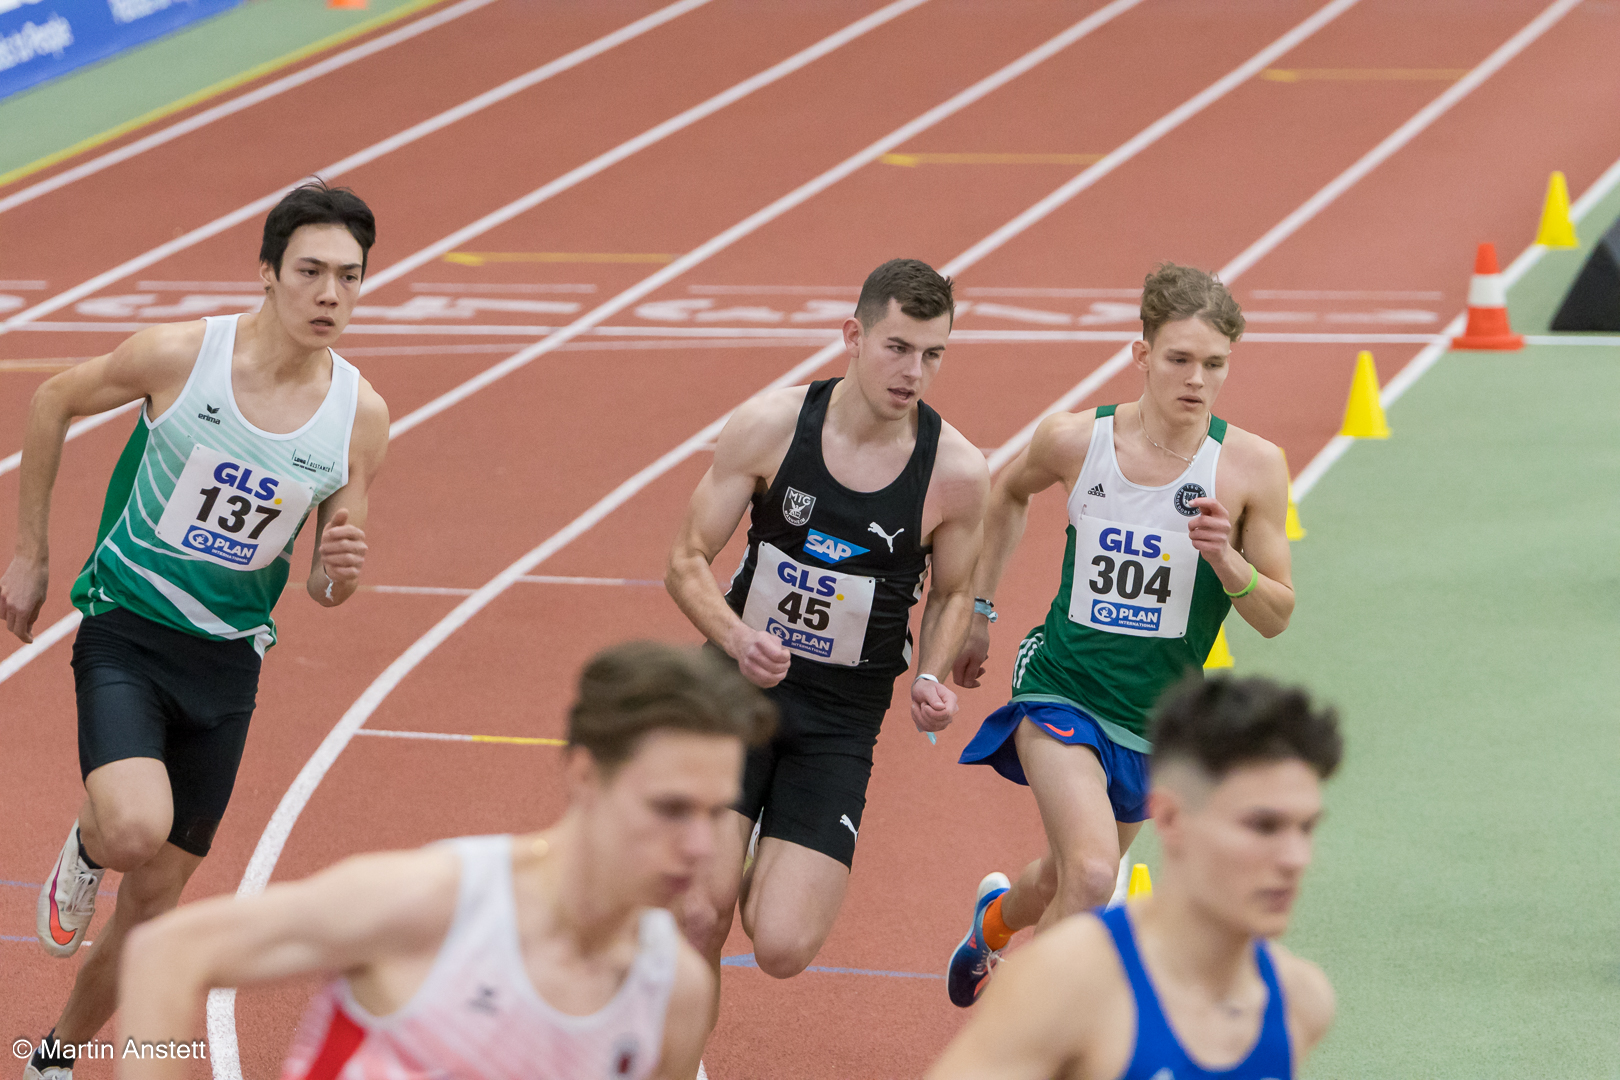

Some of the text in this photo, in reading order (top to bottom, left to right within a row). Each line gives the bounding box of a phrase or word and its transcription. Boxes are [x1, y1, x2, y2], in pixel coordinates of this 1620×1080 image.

[198, 412, 221, 425] erima
[788, 490, 811, 506] MTG
[1087, 489, 1106, 498] adidas
[196, 486, 282, 540] 137
[213, 538, 254, 558] PLAN
[805, 534, 852, 561] SAP
[211, 549, 248, 563] INTERNATIONAL
[1088, 554, 1172, 604] 304
[777, 591, 832, 631] 45
[1119, 607, 1159, 623] PLAN
[1118, 620, 1157, 629] INTERNATIONAL
[791, 642, 828, 656] INTERNATIONAL
[792, 632, 831, 651] PLAN
